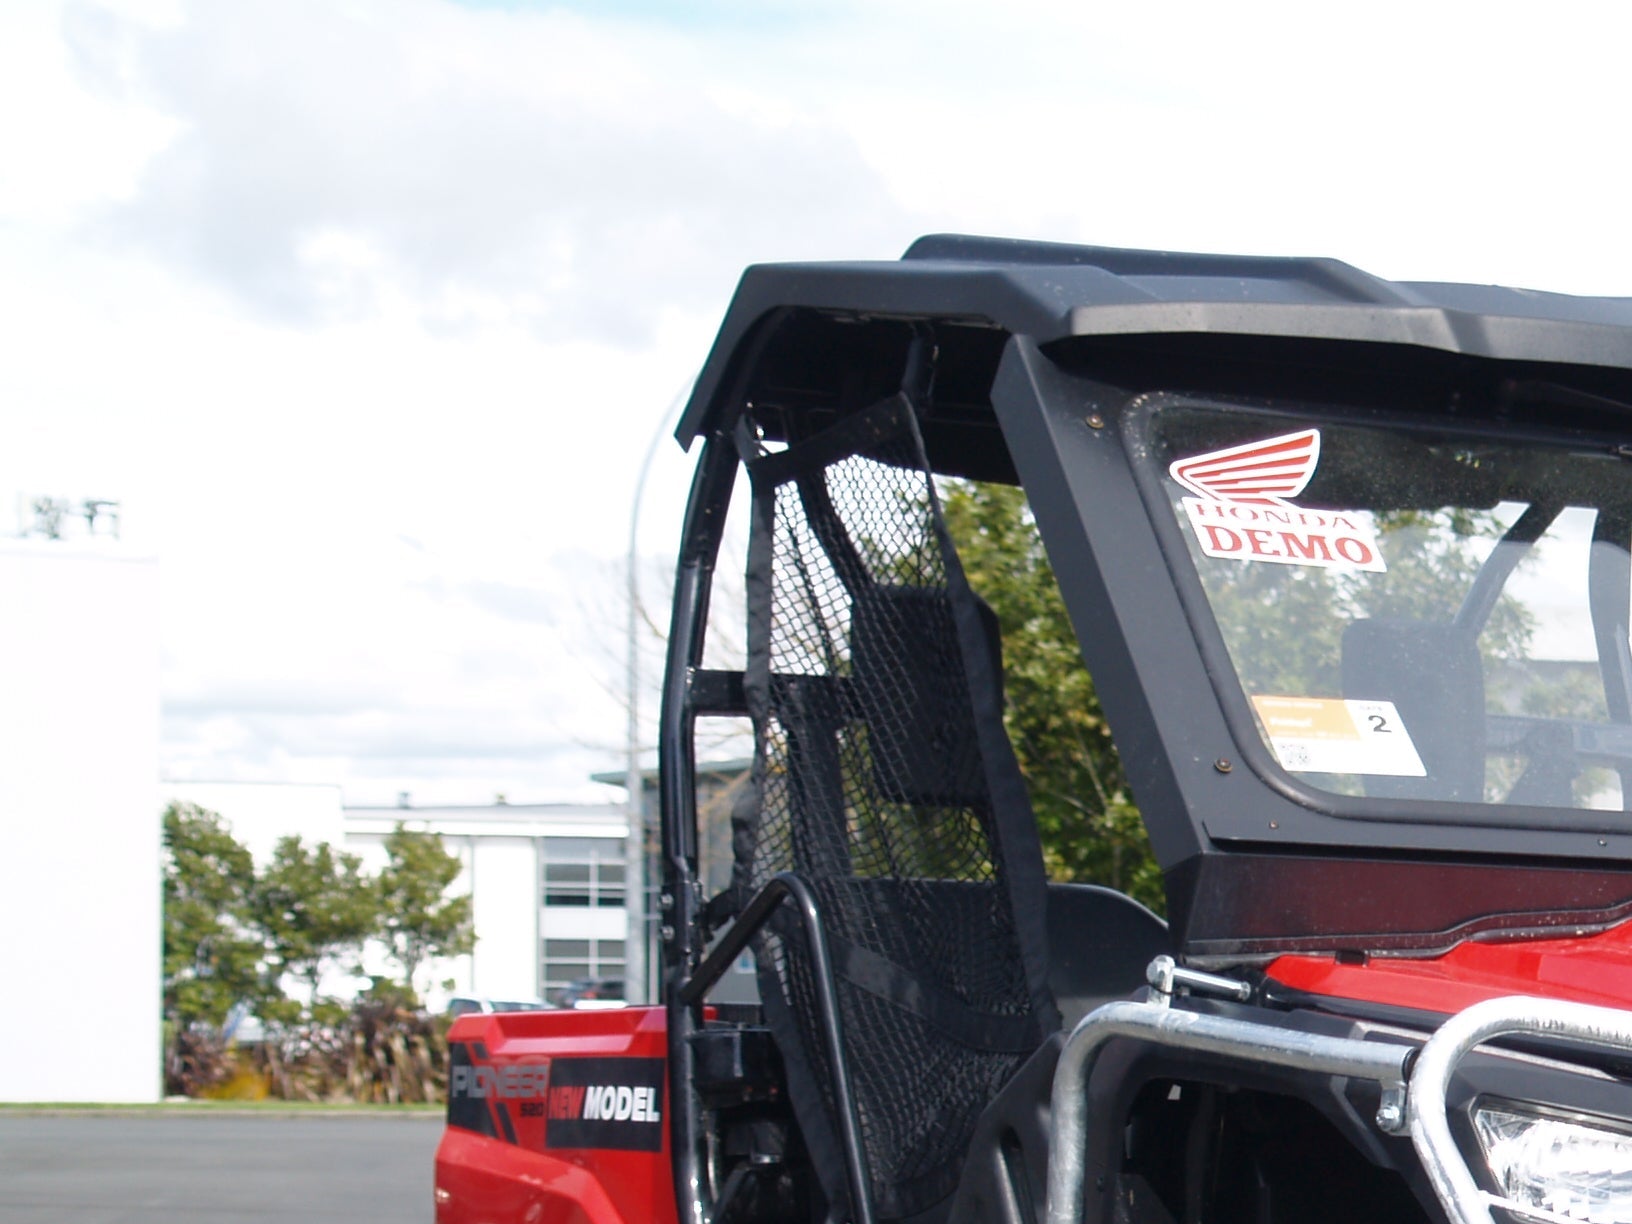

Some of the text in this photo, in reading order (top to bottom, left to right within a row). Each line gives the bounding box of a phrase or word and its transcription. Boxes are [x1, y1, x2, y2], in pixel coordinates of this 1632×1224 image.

[1199, 505, 1357, 530] HONDA
[1202, 524, 1373, 565] DEMO
[1368, 715, 1392, 733] 2
[452, 1064, 549, 1099] PIONEER
[550, 1086, 661, 1122] NEW MODEL
